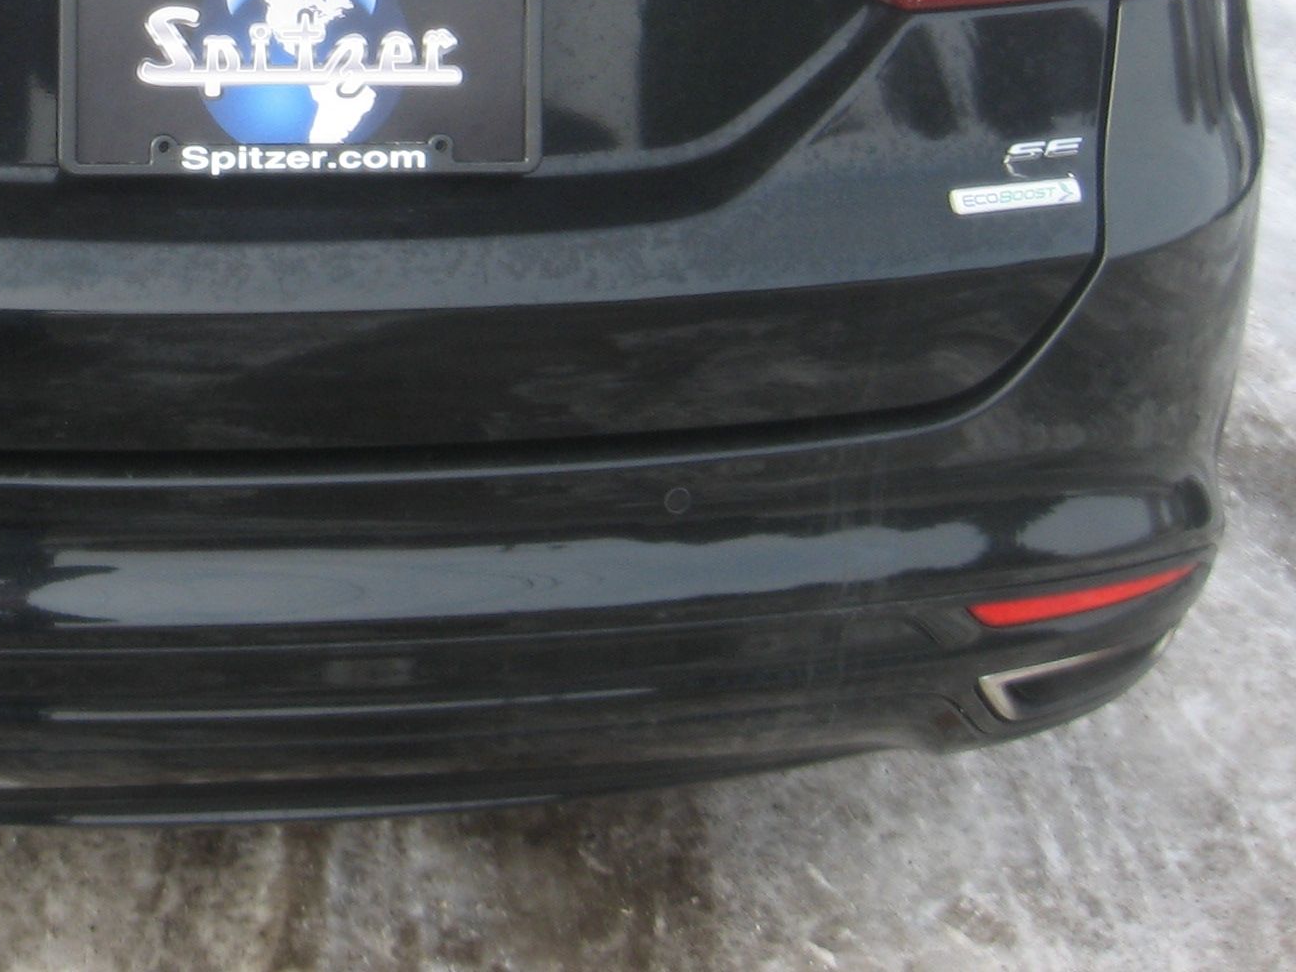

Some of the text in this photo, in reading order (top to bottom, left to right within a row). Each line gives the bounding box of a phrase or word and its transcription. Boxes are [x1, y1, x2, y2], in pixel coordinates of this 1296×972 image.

[136, 5, 463, 99] Spitzer
[181, 145, 427, 175] Spitzer.com
[1004, 137, 1083, 162] SE
